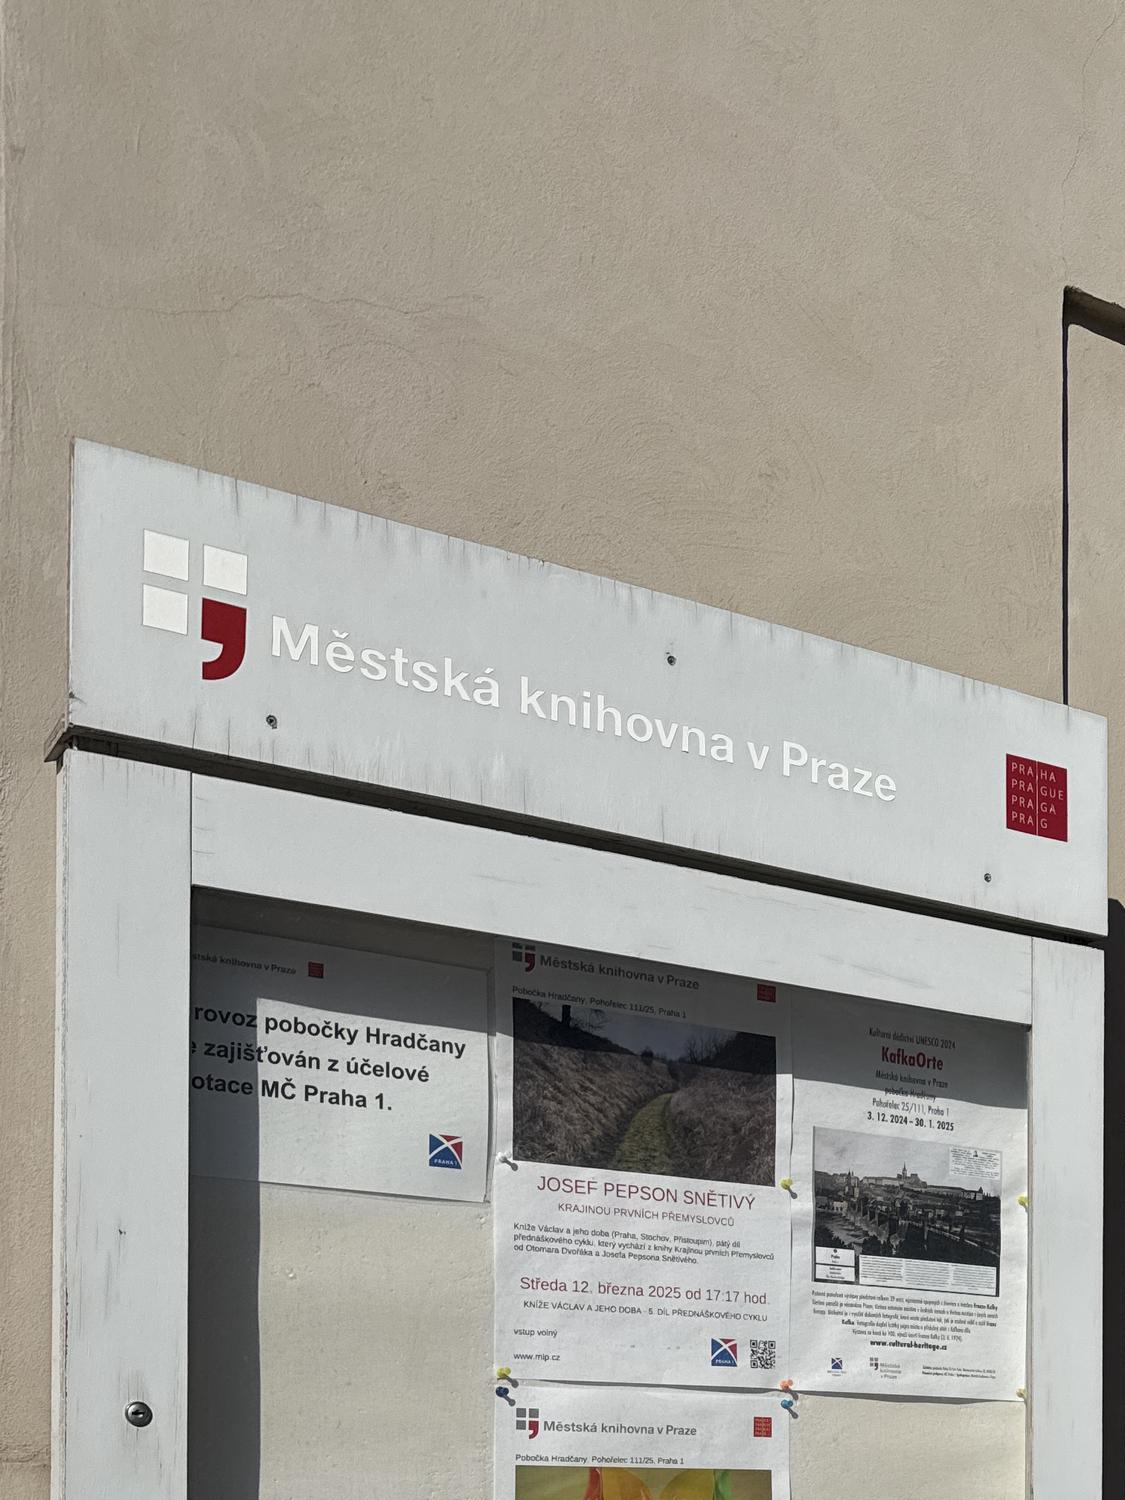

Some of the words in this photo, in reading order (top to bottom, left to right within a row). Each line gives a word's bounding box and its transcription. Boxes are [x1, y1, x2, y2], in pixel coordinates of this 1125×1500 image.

[271, 615, 500, 708] Městská
[520, 676, 734, 764] knihovna
[746, 741, 770, 770] v
[782, 740, 897, 802] Praze
[219, 956, 263, 971] knihovna
[540, 954, 595, 974] Městská
[599, 963, 655, 984] knihovna
[657, 974, 665, 984] v
[666, 973, 700, 991] Praze
[512, 985, 547, 998] Pobočka
[193, 1005, 258, 1028] rovoz
[265, 1016, 359, 1046] pobočky
[365, 1026, 467, 1060] Hradčany
[915, 1033, 940, 1048] UNESCO
[940, 1038, 956, 1049] 2024
[203, 1040, 321, 1071] zajišťován
[327, 1058, 340, 1072] z
[346, 1057, 430, 1083] účelové
[881, 1046, 944, 1071] KafkaOrte
[191, 1075, 253, 1096] otace
[261, 1078, 297, 1101] MČ
[304, 1084, 368, 1109] Praha
[375, 1092, 393, 1111] 1.
[867, 1111, 875, 1121] 3.
[877, 1112, 888, 1122] 12.
[890, 1114, 908, 1125] 2024
[915, 1117, 927, 1127] 30.
[937, 1120, 954, 1131] 2025
[537, 1175, 599, 1196] JOSEF
[603, 1182, 679, 1204] PEPSON
[683, 1188, 756, 1210] SNĚTIVÝ
[558, 1203, 611, 1216] KRAJINOU
[613, 1206, 660, 1220] PRVNÍCH
[662, 1210, 735, 1228] PŘEMYSLOVCŮ
[520, 1276, 567, 1292] Středa
[572, 1280, 593, 1294] 12.
[597, 1281, 644, 1298] března
[648, 1285, 681, 1300] 2025
[685, 1287, 701, 1301] od
[706, 1289, 740, 1303] 17:17
[523, 1299, 549, 1310] KNÍŽE
[551, 1301, 586, 1312] VÁCLAV
[594, 1304, 617, 1314] JEHO
[618, 1305, 642, 1315] DOBA
[657, 1306, 670, 1317] DÍL
[672, 1307, 741, 1321] PŘEDNÁŠKOVÉHO
[743, 1313, 768, 1322] CYKLU
[513, 1328, 535, 1338] vstup
[543, 1420, 598, 1434] Městská
[601, 1422, 655, 1435] knihovna
[657, 1427, 663, 1435] v
[665, 1425, 697, 1436] Praze
[515, 1454, 549, 1463] Pobočka
[657, 1457, 678, 1465] Praha
